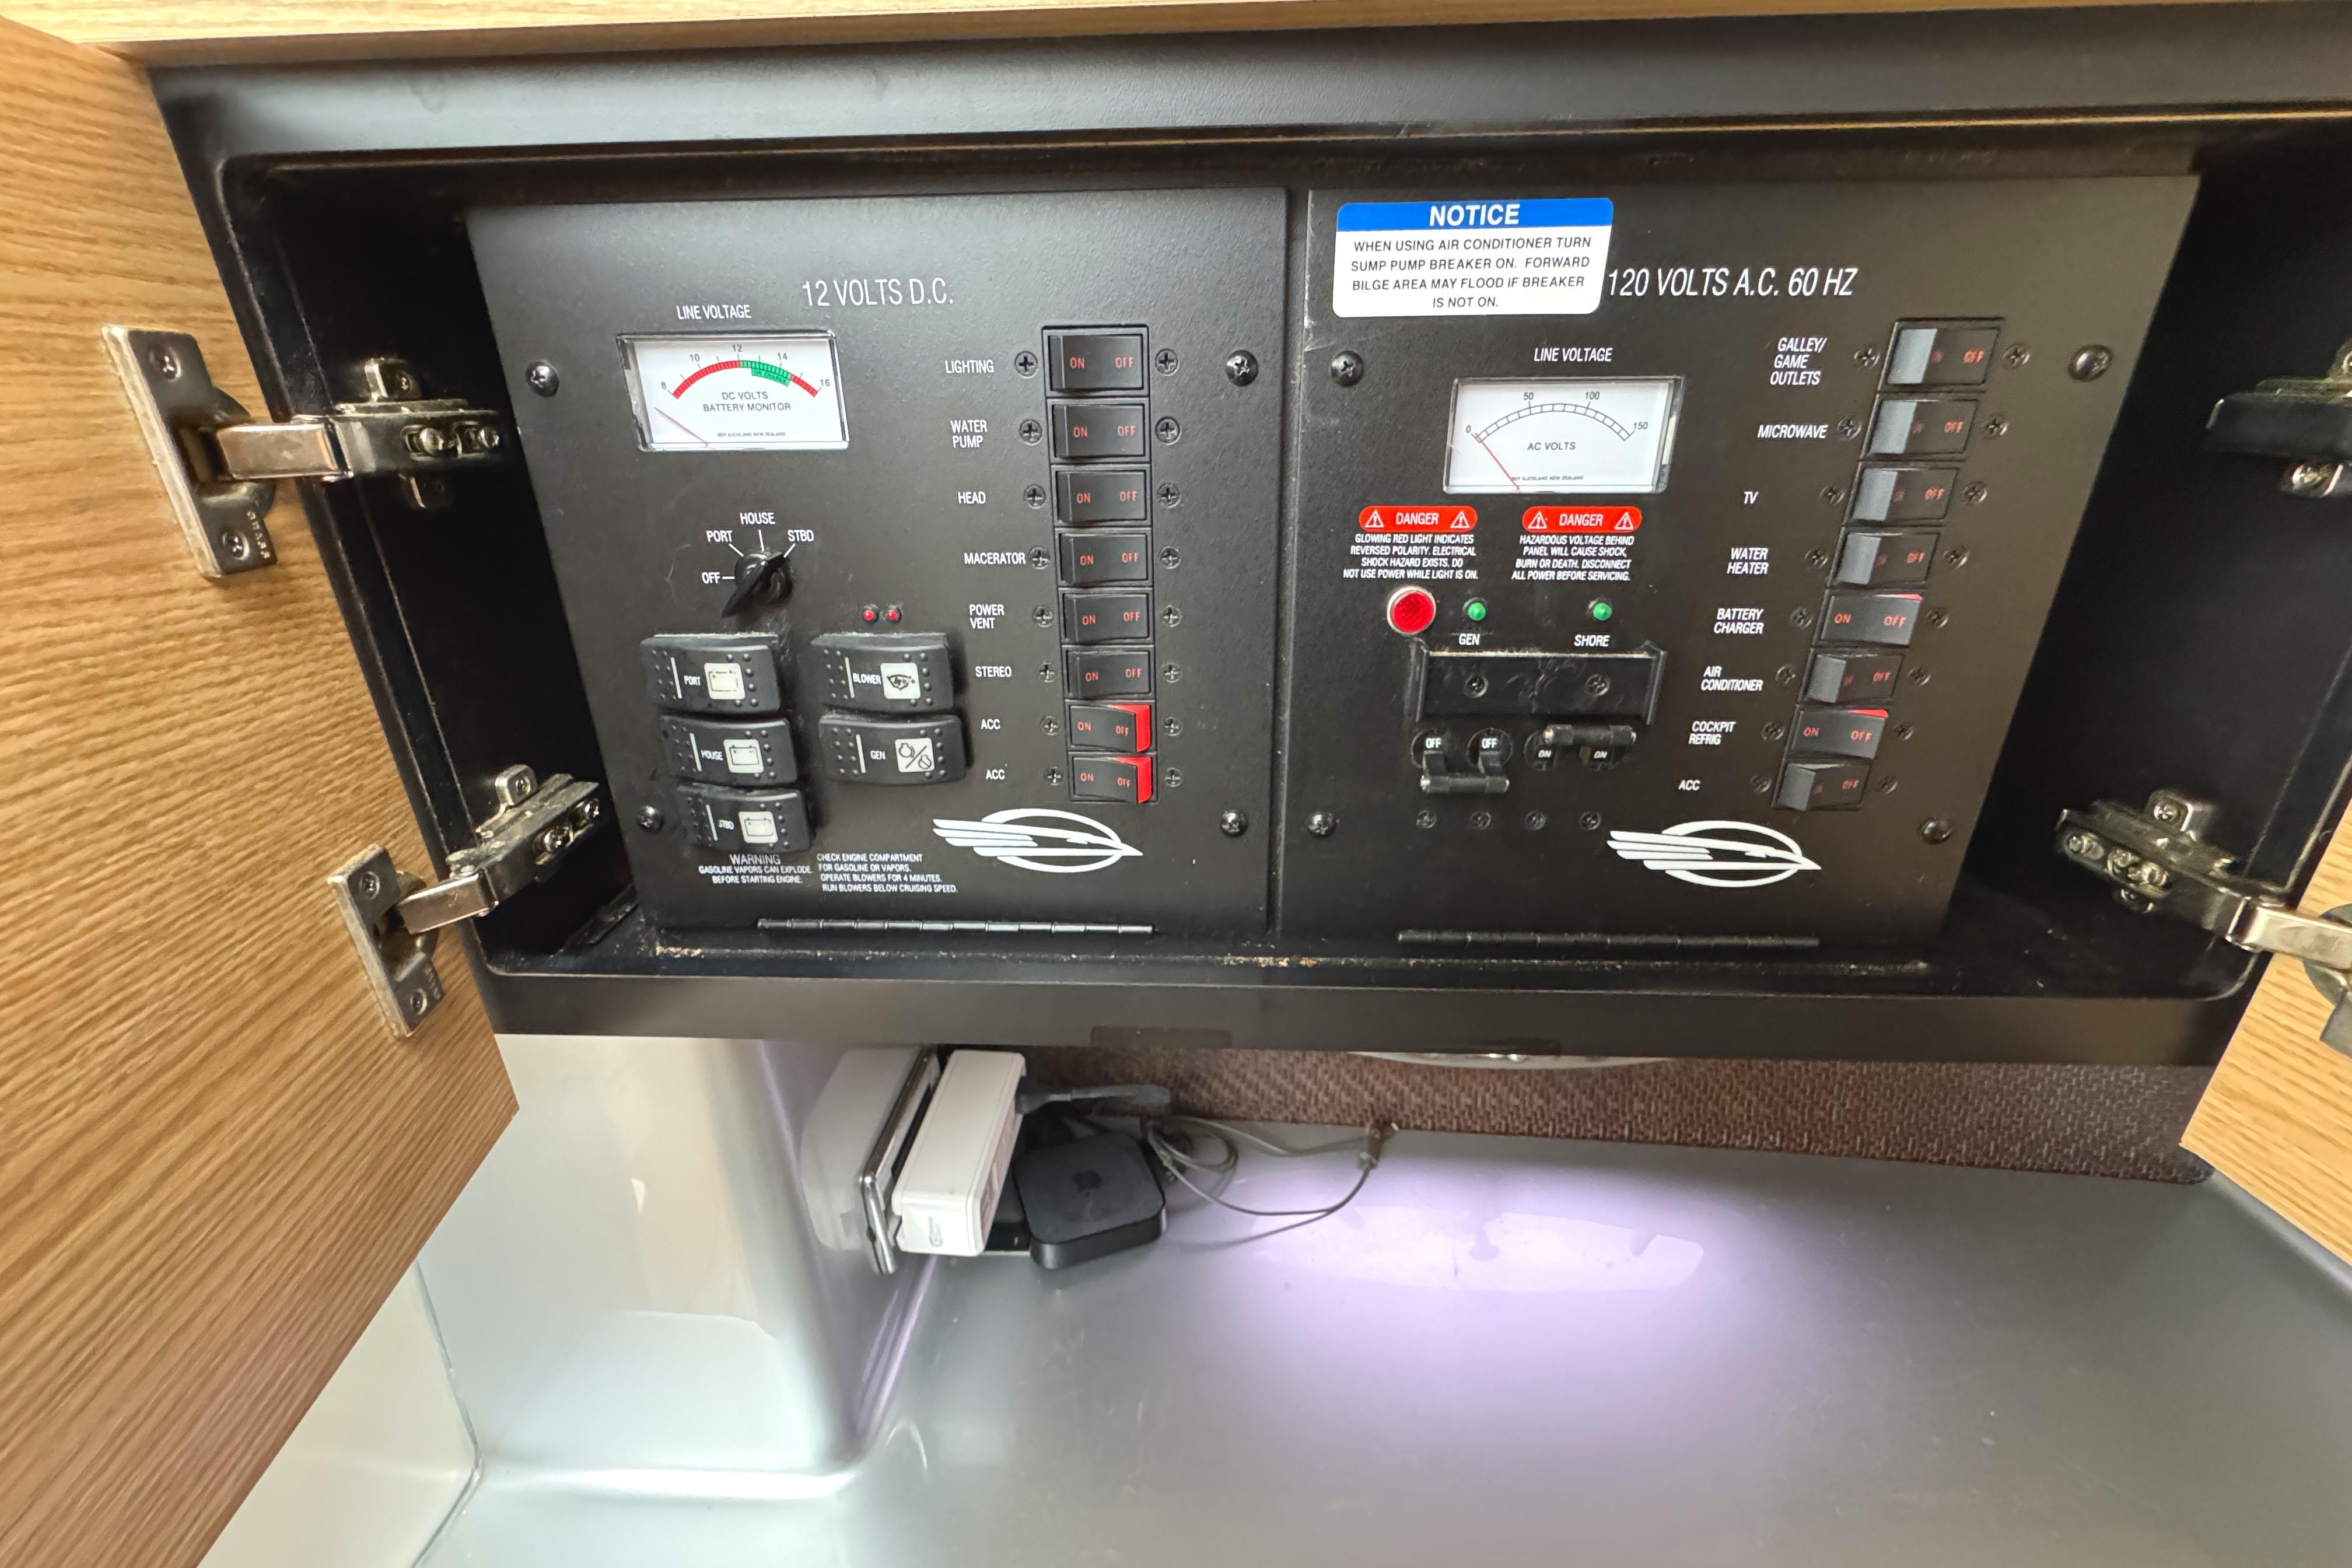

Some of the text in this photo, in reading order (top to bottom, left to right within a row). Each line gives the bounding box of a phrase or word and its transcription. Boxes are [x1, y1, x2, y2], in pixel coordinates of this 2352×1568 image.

[1429, 204, 1520, 226] NOTICE
[1354, 237, 1591, 253] WHEN USING AIR CONDITIONER TURN
[1351, 257, 1590, 272] SUMP PUMP BREAKER ON. FORWARD
[1353, 276, 1585, 291] BILGE AREA MAY FLOOD IF BREAKER
[1608, 267, 1859, 296] 120 VOLTS A.C. 60 HZ
[802, 278, 953, 307] 12 VOLTS D.C.
[1433, 297, 1499, 308] IS NOT ON.
[677, 304, 751, 320] LINE VOLTAGE
[1778, 337, 1827, 352] GALLEY/
[1534, 348, 1613, 362] LINE VOLTAGE
[945, 360, 994, 374] LIGHTING
[1070, 357, 1133, 369] ON OFF
[1774, 355, 1809, 369] GAME
[1770, 372, 1821, 385] OUTLETS
[662, 382, 667, 390] 8
[722, 391, 768, 400] DC VOLTS
[1585, 392, 1600, 400] 100
[703, 402, 791, 412] BATTERY MONITOR
[951, 420, 987, 433] WATER
[1466, 425, 1471, 433] 0
[1633, 422, 1648, 430] 150
[1758, 425, 1828, 439] MICROWAVE
[953, 435, 984, 448] PUMP
[1527, 442, 1576, 451] AC VOLTS
[958, 491, 986, 504] HEAD
[1744, 492, 1758, 505] TV
[740, 513, 775, 526] HOUSE
[1396, 513, 1438, 525] DANGER
[1559, 514, 1603, 526] DANGER
[706, 530, 733, 543] PORT
[788, 530, 814, 542] STBD
[1355, 534, 1475, 544] GLOWING RED LIGHT INDICATES
[1520, 535, 1634, 545] HAZARDOUS VOLTAGE BEHIND
[1350, 545, 1476, 556] REVERSED POLARITY. ELECTRICAL
[1523, 547, 1627, 558] PANEL WILL CAUSE SHOCK,
[1731, 548, 1768, 560] WATER
[964, 552, 1026, 565] MACERATOR
[1362, 558, 1463, 567] SHOCK HAZARD EXISTS. DO
[1516, 559, 1632, 569] BURN OR DEATH. DISCONNECT
[1343, 569, 1478, 579] NOT USE POWER WHILE LIGHT IS ON.
[1727, 562, 1769, 575] HEATER
[702, 572, 720, 583] OFF
[1511, 570, 1630, 580] ALL POWER BEFORE SERVICING.
[969, 604, 1005, 616] POWER
[1717, 608, 1763, 621] BATTERY
[970, 618, 995, 629] VENT
[1834, 614, 1906, 627] ON OFF
[1714, 622, 1764, 634] CHARGER
[1458, 634, 1480, 646] GEN
[1574, 635, 1610, 647] SHORE
[975, 666, 1012, 678] STEREO
[1704, 666, 1722, 677] AIR
[684, 676, 701, 686] PORT
[853, 673, 881, 685] BLOWER
[1701, 680, 1763, 691] CONDITIONER
[981, 719, 1000, 730] ACC
[1078, 722, 1129, 736] ON OFF
[1692, 721, 1736, 732] COCKPIT
[1689, 733, 1721, 745] REFRIG
[1803, 727, 1871, 742] ON OFF
[701, 750, 723, 761] HOUSE
[870, 750, 886, 760] GEN
[986, 769, 1005, 780] ACC
[1678, 779, 1700, 791] ACC
[718, 819, 734, 830] STBD
[730, 854, 781, 865] WARNING
[817, 853, 923, 862] CHECK ENGINE COMPARTMENT
[699, 866, 733, 874] GASOLINE
[734, 866, 763, 874] VAPORS
[780, 866, 813, 874] EXPLODE.
[834, 863, 869, 872] GASOLINE
[882, 864, 912, 872] VAPORS.
[712, 876, 740, 884] BEFORE
[820, 874, 851, 882] OPERATE
[853, 874, 886, 882] BLOWERS
[888, 874, 901, 882] FOR
[909, 874, 943, 883] MINUTES.
[822, 884, 958, 893] RUN BLOWERS BELOW CRUISING SPEED.
